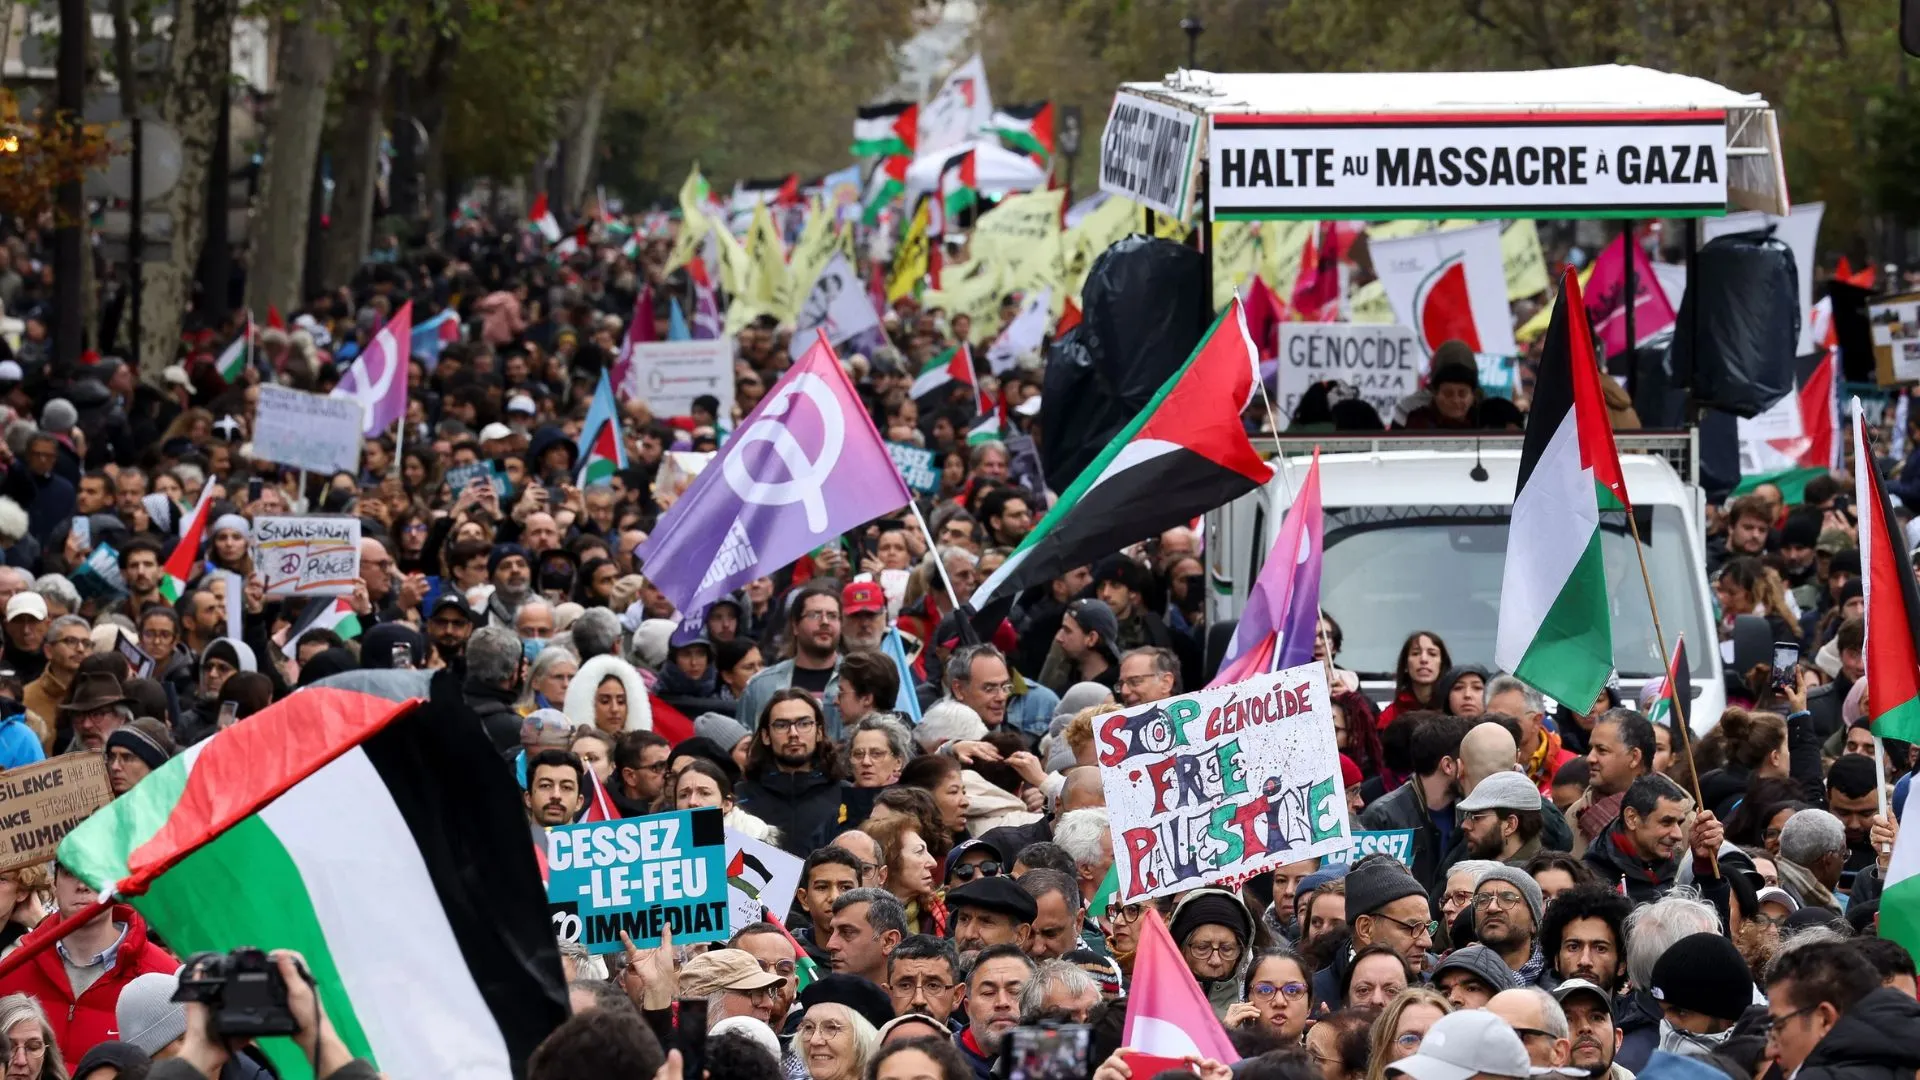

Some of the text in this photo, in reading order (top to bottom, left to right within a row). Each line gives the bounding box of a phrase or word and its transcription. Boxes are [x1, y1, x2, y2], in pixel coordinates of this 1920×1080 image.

[1221, 144, 1719, 188] HALTE AU MASSACRE À GAZA
[1288, 328, 1413, 370] GÉNOCIDE
[1099, 698, 1201, 768] STOP
[1146, 736, 1248, 818] FREE
[548, 818, 682, 872] CESSEZ
[1122, 774, 1343, 901] PALESTINE
[578, 856, 708, 909] -LE-FEU
[585, 901, 727, 945] IMMÉDIAT
